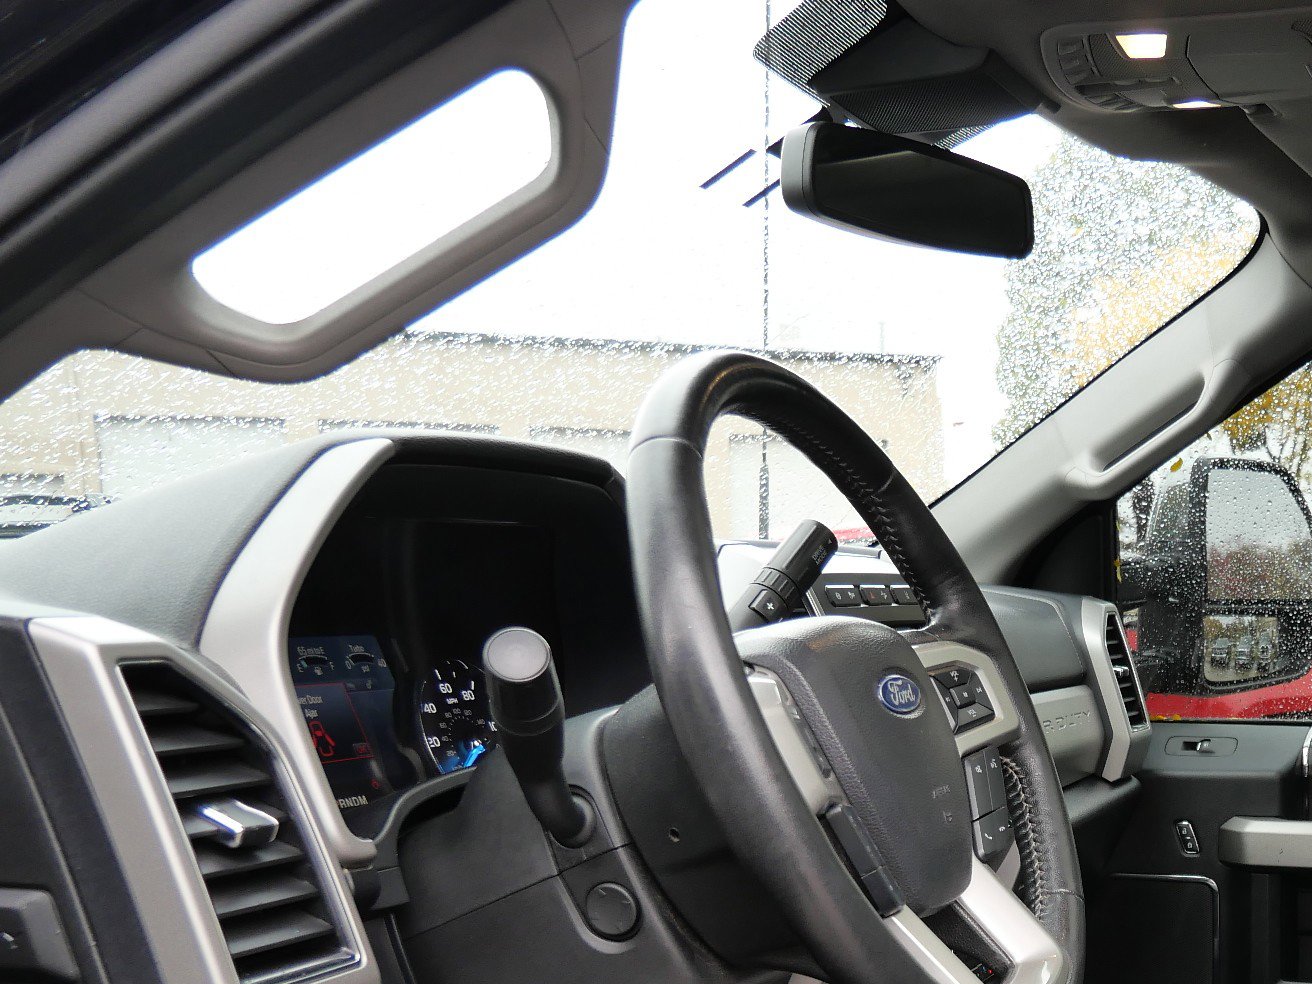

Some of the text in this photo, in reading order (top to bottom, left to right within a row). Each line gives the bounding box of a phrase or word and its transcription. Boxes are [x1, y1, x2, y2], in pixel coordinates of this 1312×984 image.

[439, 683, 453, 694] 60
[887, 680, 916, 706] Ford
[462, 690, 476, 701] 80
[423, 703, 437, 714] 40
[336, 795, 369, 809] RNDM
